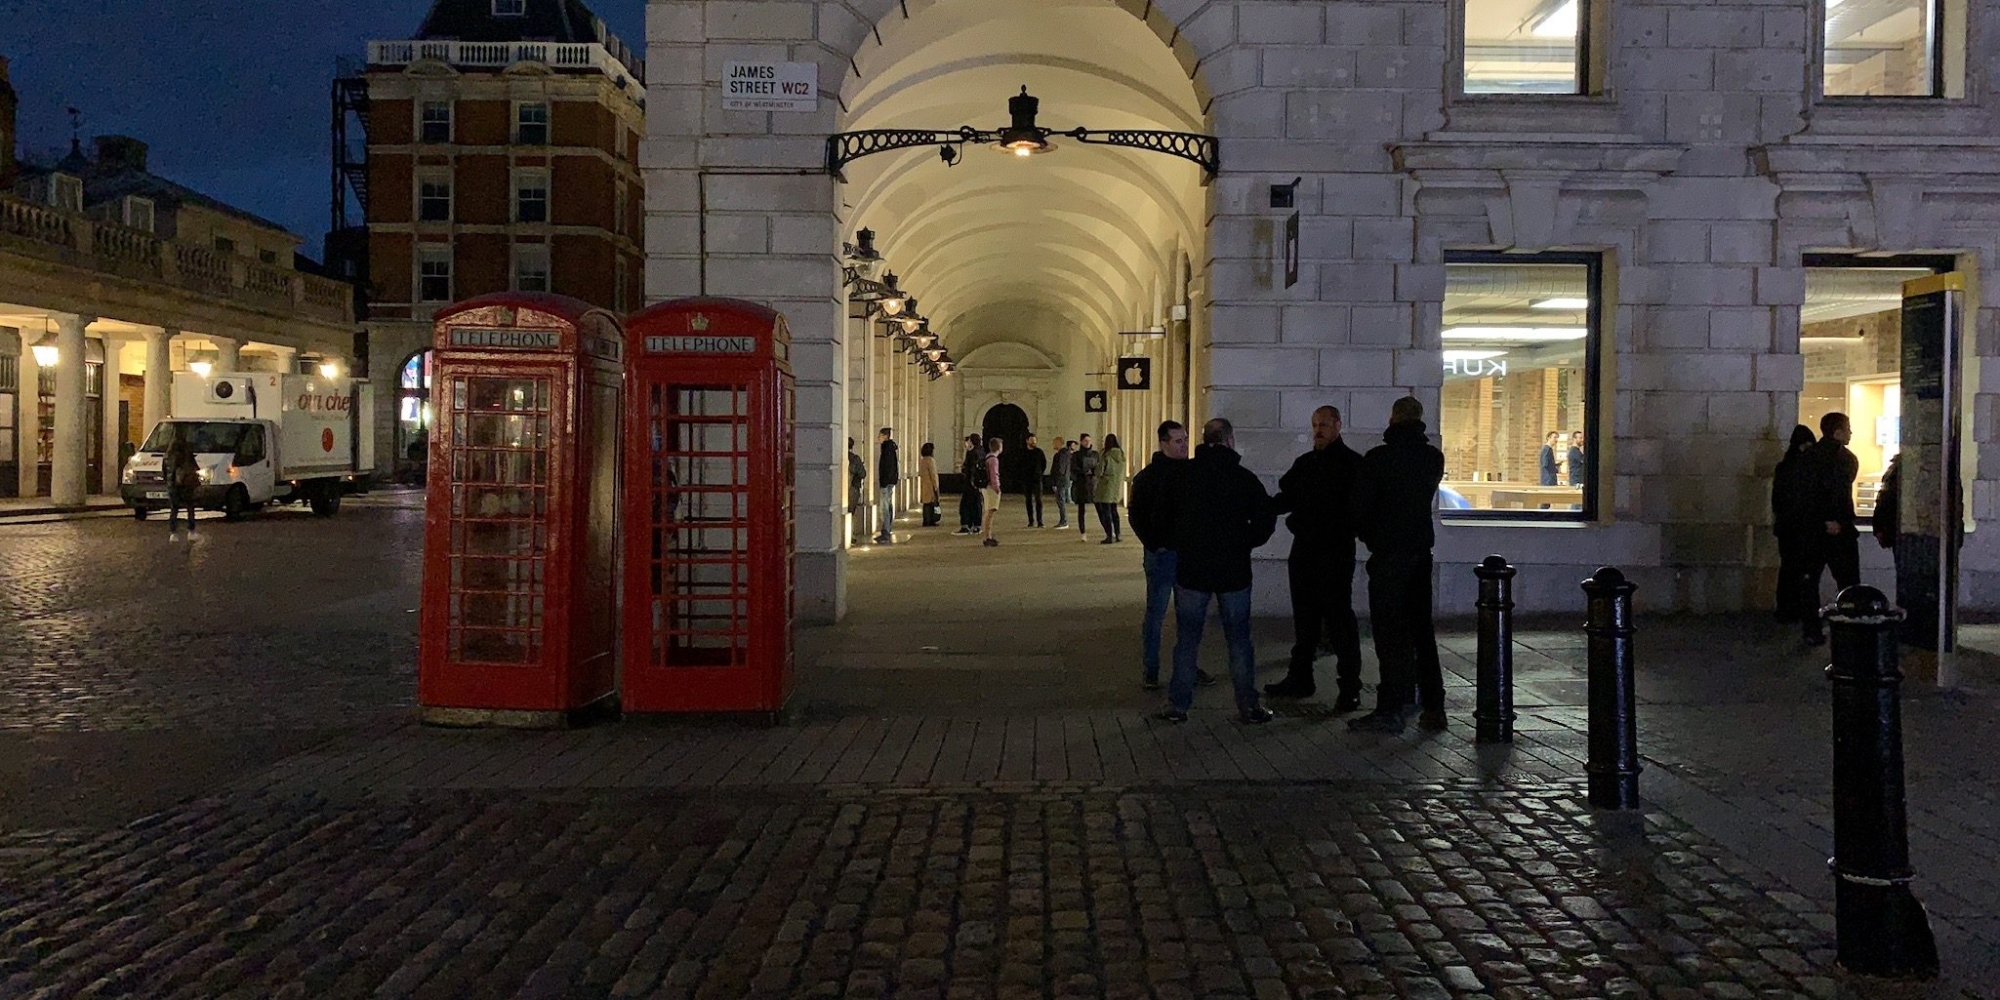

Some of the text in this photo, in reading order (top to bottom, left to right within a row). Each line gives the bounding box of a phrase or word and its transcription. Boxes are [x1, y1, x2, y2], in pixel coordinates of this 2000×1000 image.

[730, 66, 774, 78] JAMES
[730, 81, 809, 95] STREET WC2
[457, 331, 556, 348] TELEPHONE
[651, 337, 752, 351] TELEPHONE
[270, 376, 276, 386] 2
